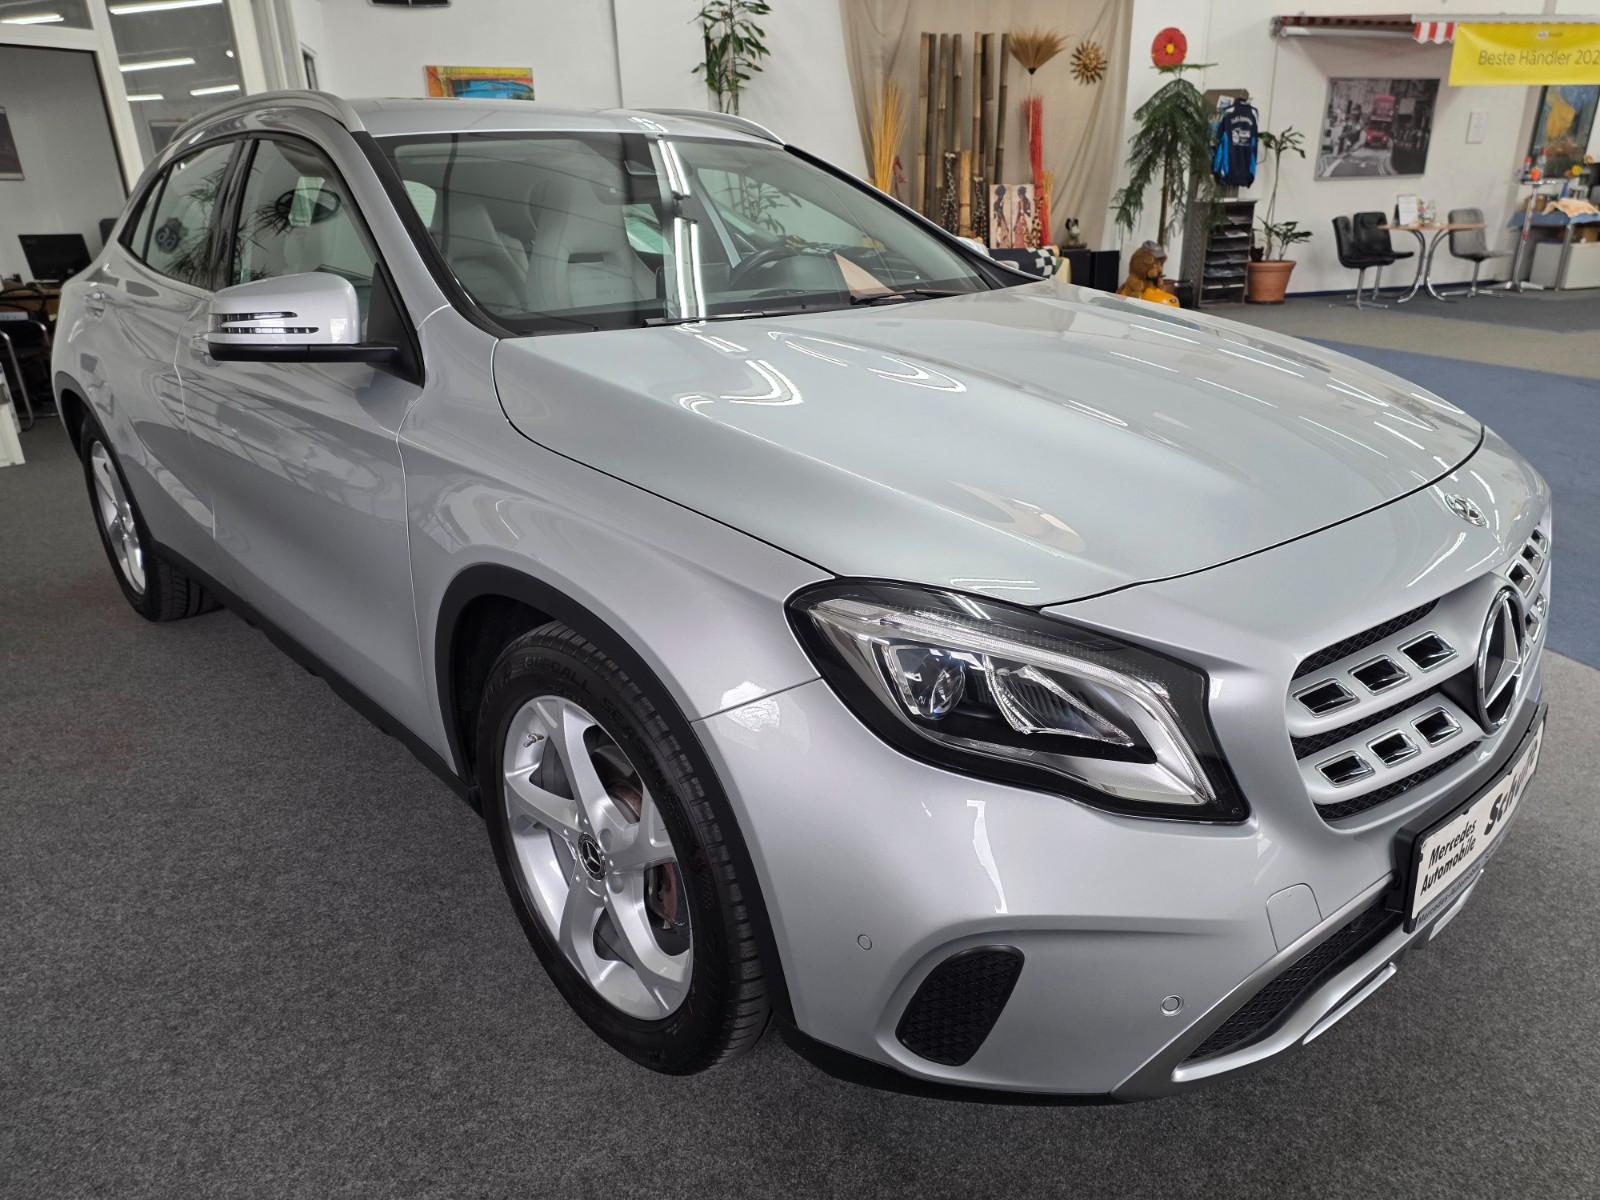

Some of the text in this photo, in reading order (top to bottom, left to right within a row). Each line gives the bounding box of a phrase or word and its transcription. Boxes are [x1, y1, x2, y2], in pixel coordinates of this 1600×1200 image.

[1478, 50, 1516, 66] Beste
[1519, 48, 1572, 66] Händler
[1420, 836, 1477, 897] Automobile
[1428, 819, 1477, 870] Mercedes
